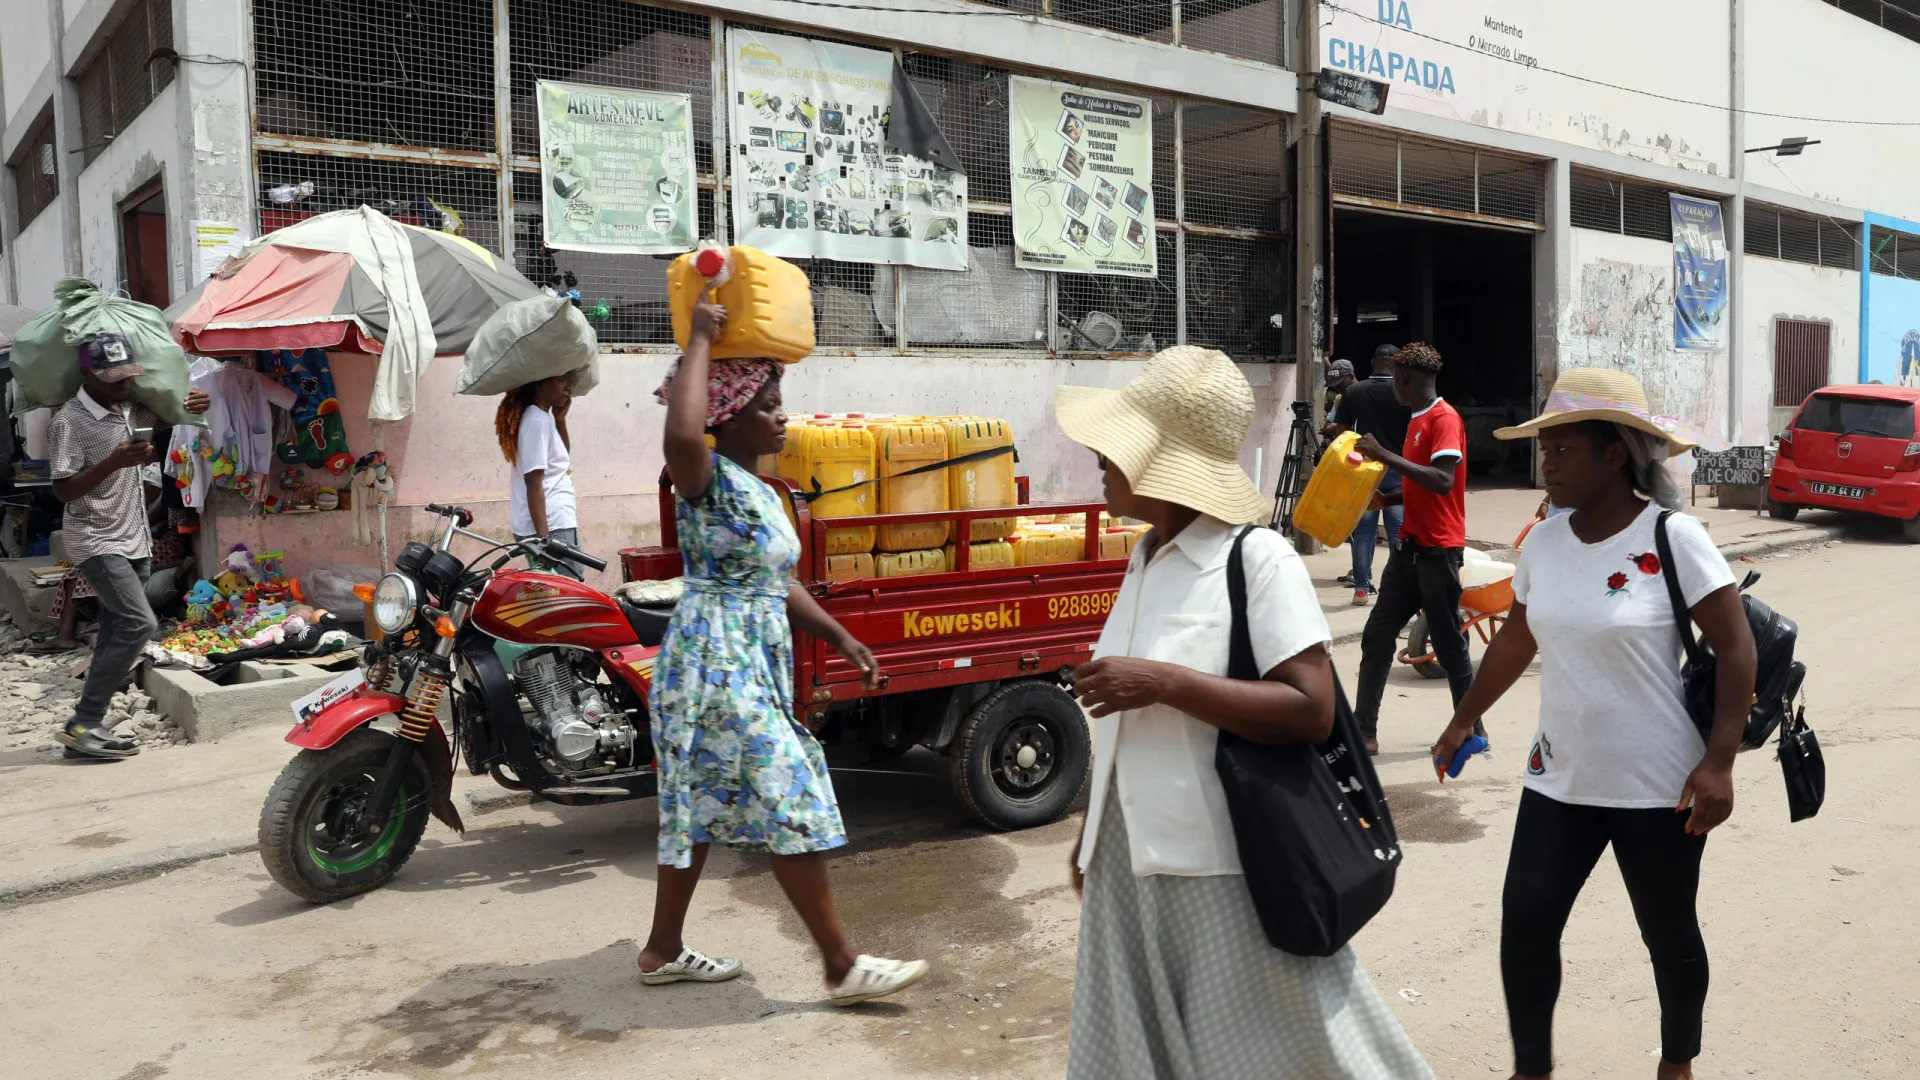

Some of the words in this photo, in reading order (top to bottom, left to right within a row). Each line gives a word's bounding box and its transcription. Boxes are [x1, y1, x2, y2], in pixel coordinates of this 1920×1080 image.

[1378, 0, 1413, 30] DA
[1484, 15, 1523, 39] Mantenha
[1469, 35, 1475, 47] O
[1478, 37, 1510, 58] Mercado
[1514, 48, 1538, 70] Limpo
[787, 67, 800, 79] DE
[1328, 37, 1456, 94] CHAPADA
[567, 91, 619, 115] ARTES
[624, 98, 665, 122] NEVE
[594, 112, 645, 126] COMERCIAL
[1084, 114, 1104, 125] NOSSOS
[1678, 203, 1713, 218] REPARAÇÃO
[1719, 458, 1731, 468] DE
[1708, 468, 1722, 483] DE
[1725, 467, 1760, 485] CARRO
[1827, 486, 1836, 494] 29
[1839, 487, 1848, 496] 64
[1850, 488, 1861, 497] ER
[903, 602, 1021, 638] Keweseki
